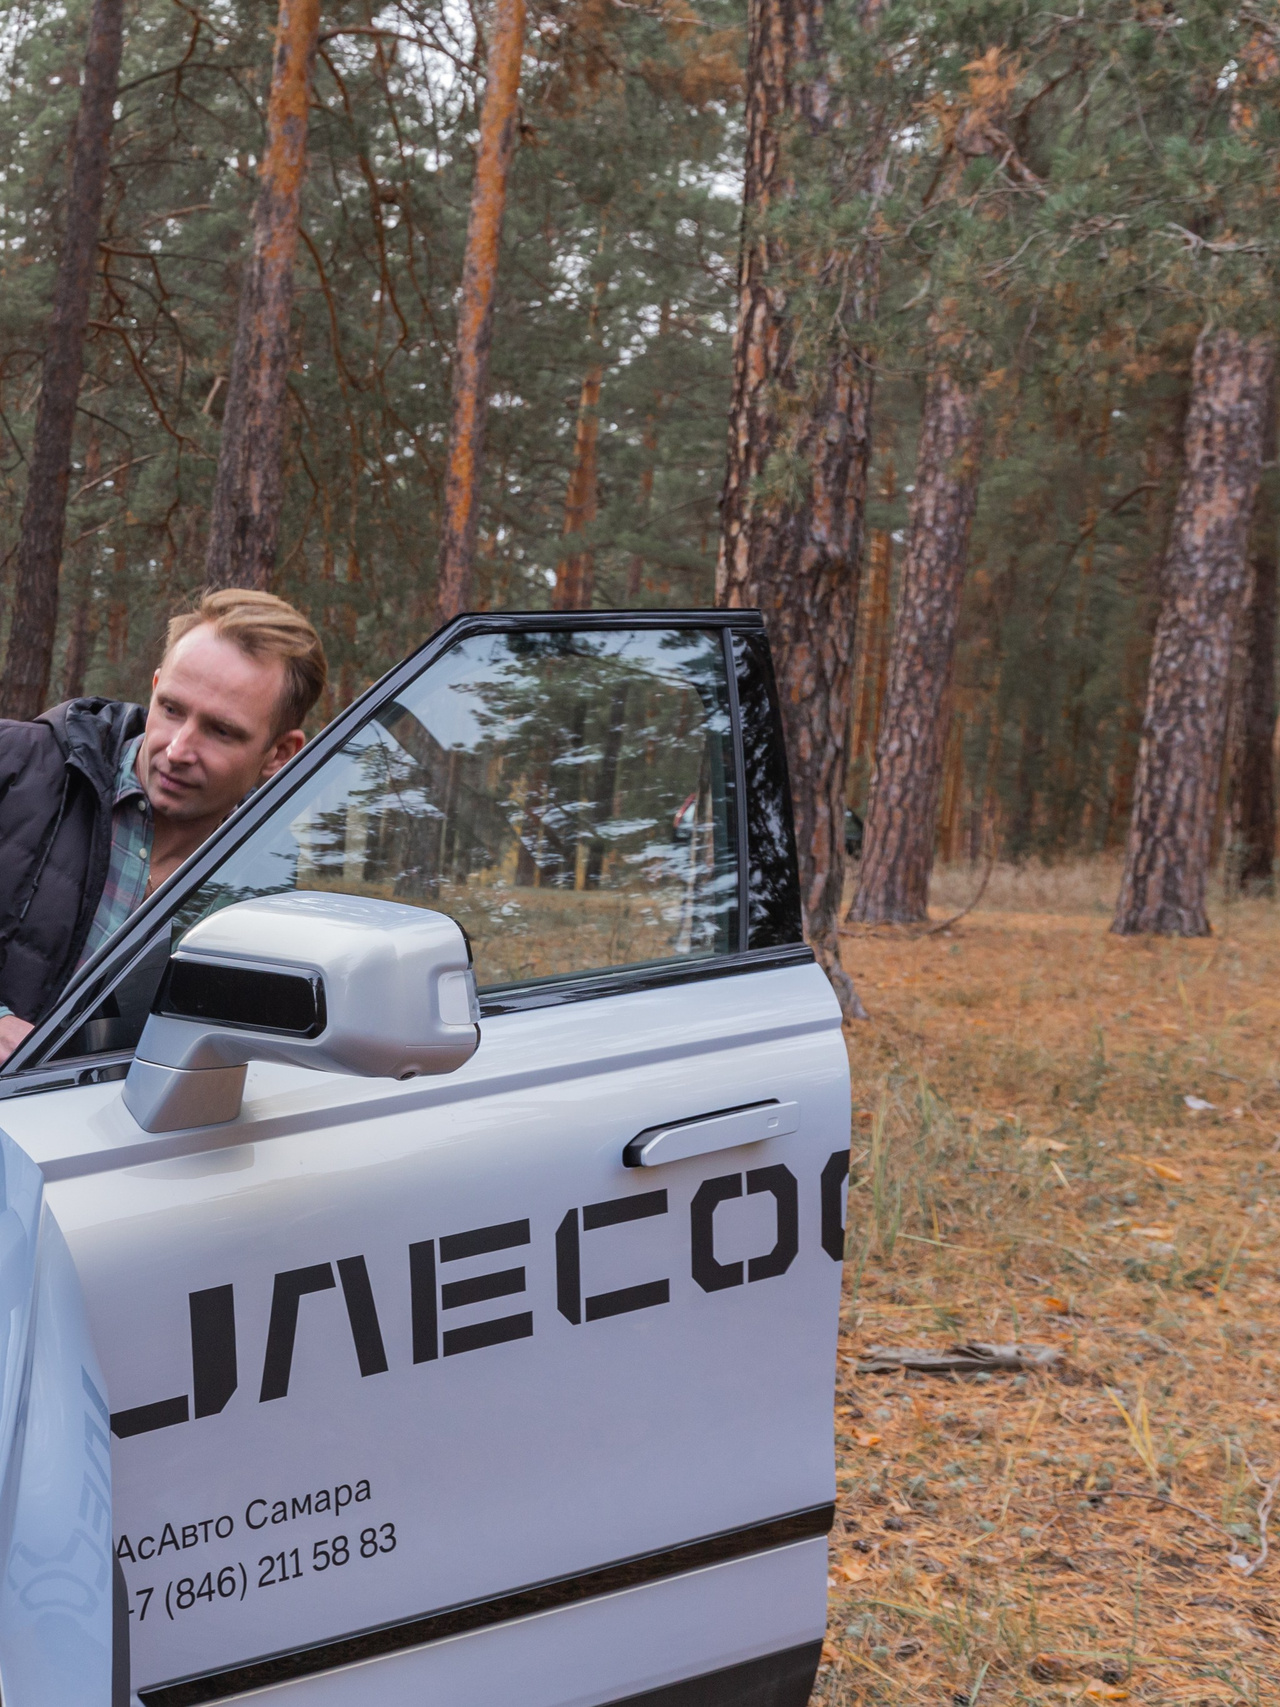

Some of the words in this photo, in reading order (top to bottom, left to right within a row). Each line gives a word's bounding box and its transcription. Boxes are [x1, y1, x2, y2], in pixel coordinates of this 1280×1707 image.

[109, 1149, 851, 1439] JAECO
[245, 1479, 371, 1530] Самара
[164, 1562, 247, 1620] (846)
[257, 1547, 304, 1588] 211
[311, 1535, 350, 1571] 58
[358, 1522, 397, 1559] 83
